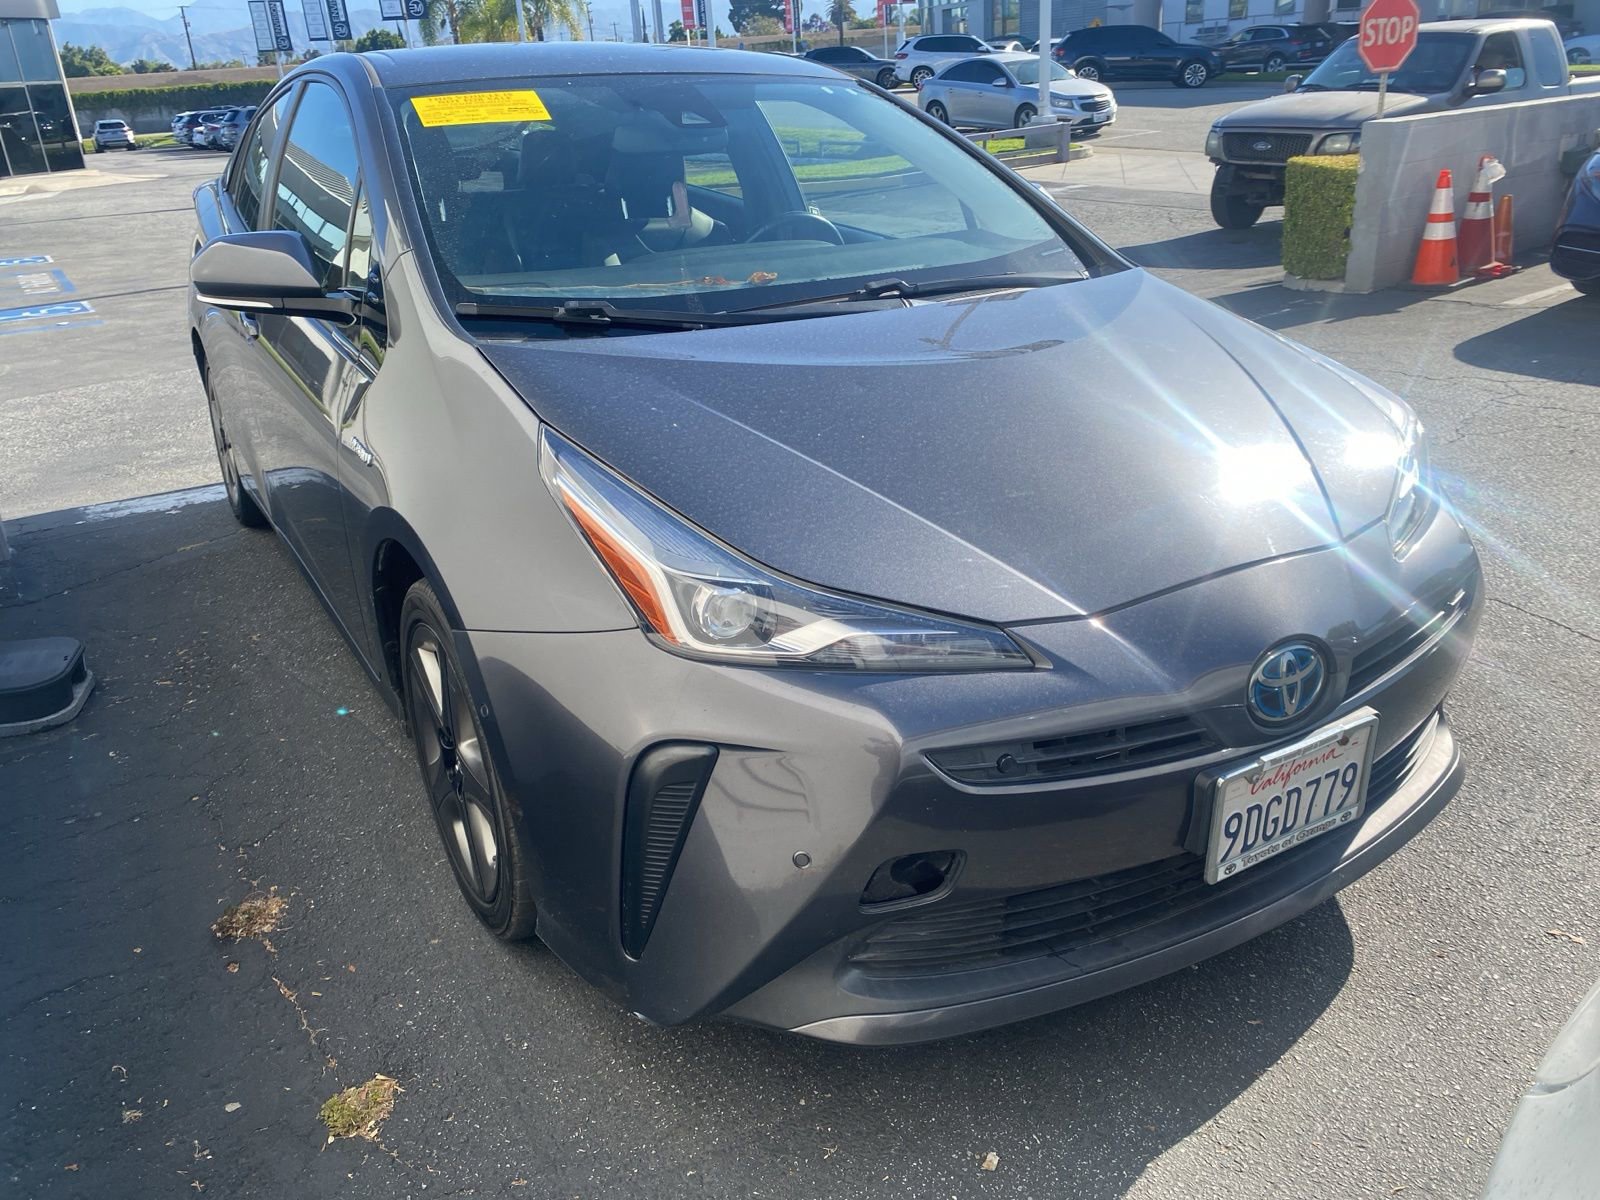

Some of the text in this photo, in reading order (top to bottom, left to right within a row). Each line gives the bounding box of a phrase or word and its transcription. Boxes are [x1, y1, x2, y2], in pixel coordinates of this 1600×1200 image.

[1364, 16, 1413, 46] STOP
[1250, 747, 1344, 795] California
[1221, 762, 1358, 863] 9DGD779
[1241, 843, 1280, 867] Toyota
